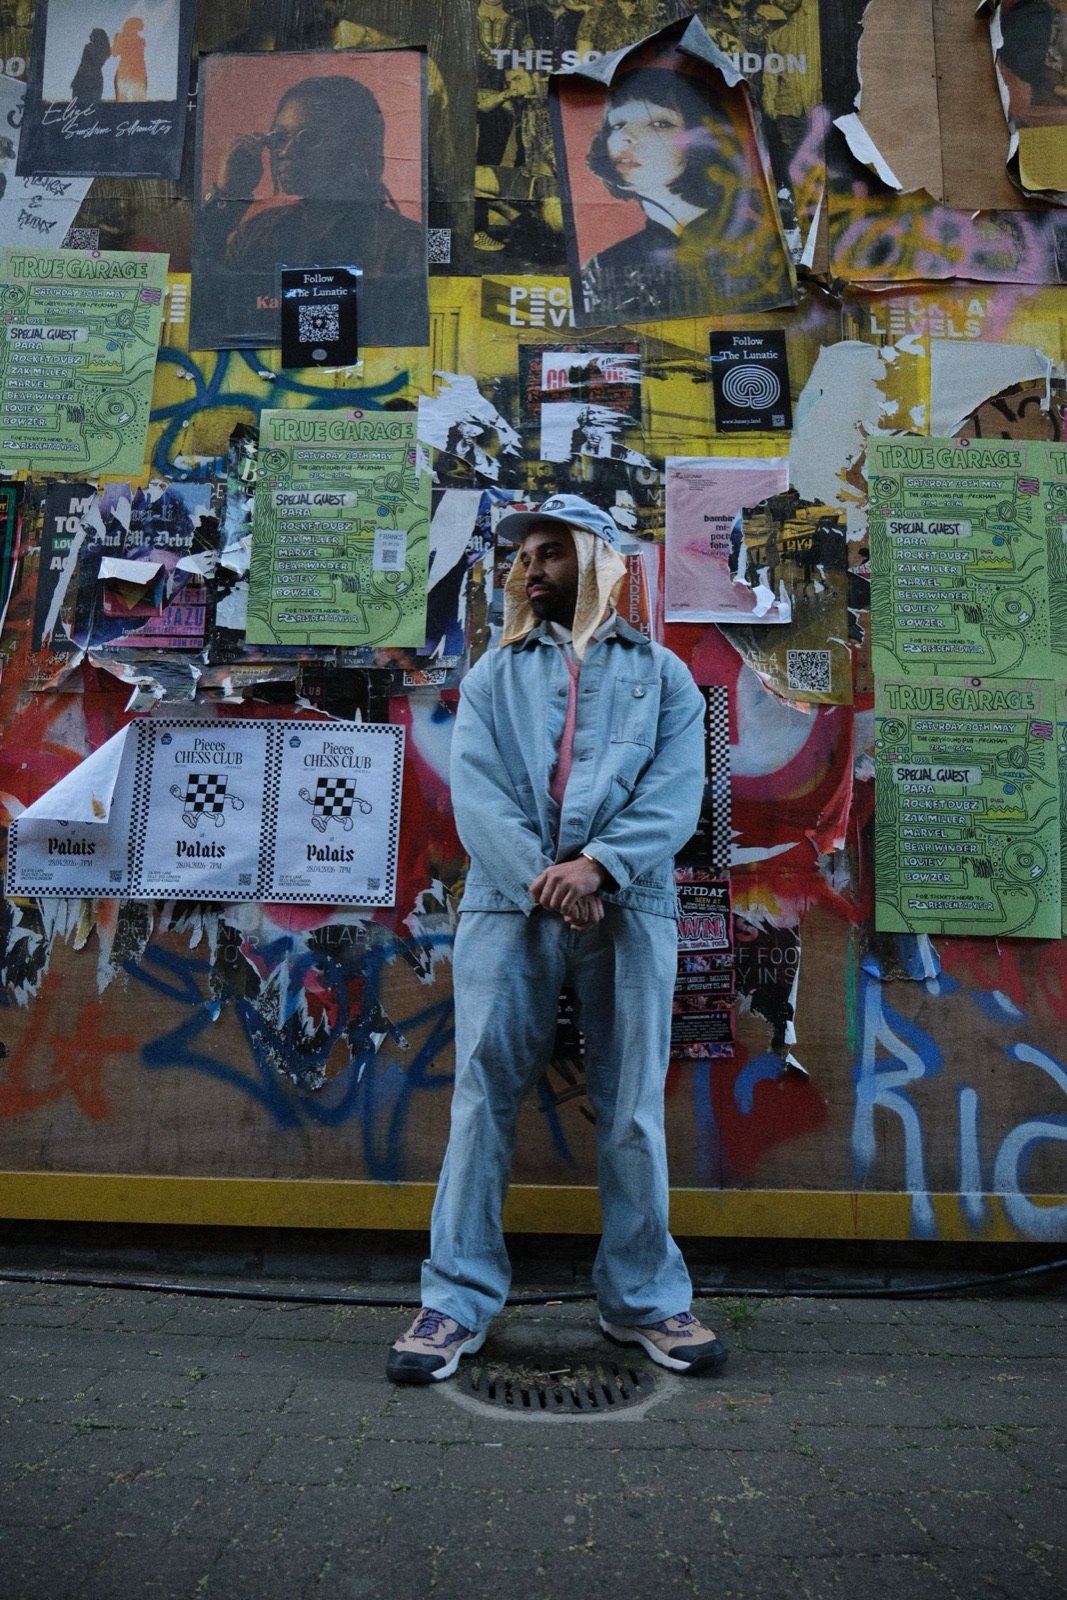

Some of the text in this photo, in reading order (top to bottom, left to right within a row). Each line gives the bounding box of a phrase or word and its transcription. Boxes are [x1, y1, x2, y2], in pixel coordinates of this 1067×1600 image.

[490, 49, 552, 70] THE
[0, 56, 25, 77] O
[10, 256, 148, 279] TRUE GARAGE
[304, 274, 334, 283] Follow
[34, 287, 79, 297] SATURDAY
[105, 289, 127, 298] MAY
[290, 287, 348, 297] The Lunatic
[510, 287, 572, 306] PEC
[256, 296, 281, 309] Ka
[870, 316, 981, 337] LEVELS
[10, 328, 78, 341] SPECIAL GUEST
[14, 342, 43, 350] PARA
[732, 336, 764, 346] Follow
[12, 354, 52, 364] ROCKET
[719, 350, 778, 360] The Lunatic
[11, 366, 68, 376] ZAK MILLER
[8, 380, 49, 388] MARVEL
[35, 392, 74, 401] WINDER
[35, 404, 43, 412] V
[4, 418, 46, 426] BOWZER
[269, 418, 414, 442] TRUE GARAGE
[297, 451, 343, 460] SATURDAY
[372, 452, 393, 460] MAY
[877, 445, 1021, 469] TRUE GARAGE
[908, 479, 953, 488] SATURDAY
[982, 480, 1003, 489] MAY
[276, 494, 346, 506] SPECIAL GUEST
[281, 508, 311, 517] PARA
[280, 522, 321, 530] ROCKET
[890, 522, 960, 535] SPECIAL GUEST
[125, 531, 151, 550] Me
[153, 531, 194, 550] Debu
[280, 535, 339, 543] ZAK MILLER
[896, 537, 927, 545] PARA
[278, 548, 321, 556] MARVEL
[896, 551, 969, 560] ROCKET DUBZ
[278, 562, 348, 570] BEAR WINDER
[897, 564, 957, 573] ZAK MILLER
[308, 575, 316, 583] V
[897, 578, 939, 586] MARVEL
[276, 588, 321, 597] BOWZER
[629, 556, 640, 624] HUNDRED
[898, 591, 969, 600] BEAR WINDER
[899, 619, 945, 628] BOWZER
[884, 684, 1034, 711] TRUE GARAGE
[915, 721, 964, 731] SATURDAY
[993, 722, 1016, 732] MAY
[194, 738, 226, 751] Pieces
[323, 742, 355, 755] Pieces
[175, 751, 243, 765] CHESS CLUB
[304, 755, 372, 769] CHESS CLUB
[897, 768, 969, 783] SPECIAL GUEST
[903, 784, 935, 794] PARA
[903, 799, 978, 809] ROCKET DUBZ
[904, 813, 965, 824] ZAK MILLER
[903, 829, 948, 837] MARVEL
[48, 838, 96, 856] Palais
[176, 840, 227, 858] Palais
[904, 843, 977, 853] BEAR WINDER
[307, 844, 355, 862] Palais
[81, 859, 93, 867] 7PM
[209, 862, 222, 870] 7PM
[904, 857, 945, 866] LOUIE V
[904, 873, 951, 882] BOWZER
[676, 886, 727, 898] FRIDAY
[678, 917, 721, 938] WN
[758, 947, 798, 964] FOO
[758, 967, 777, 984] IN
